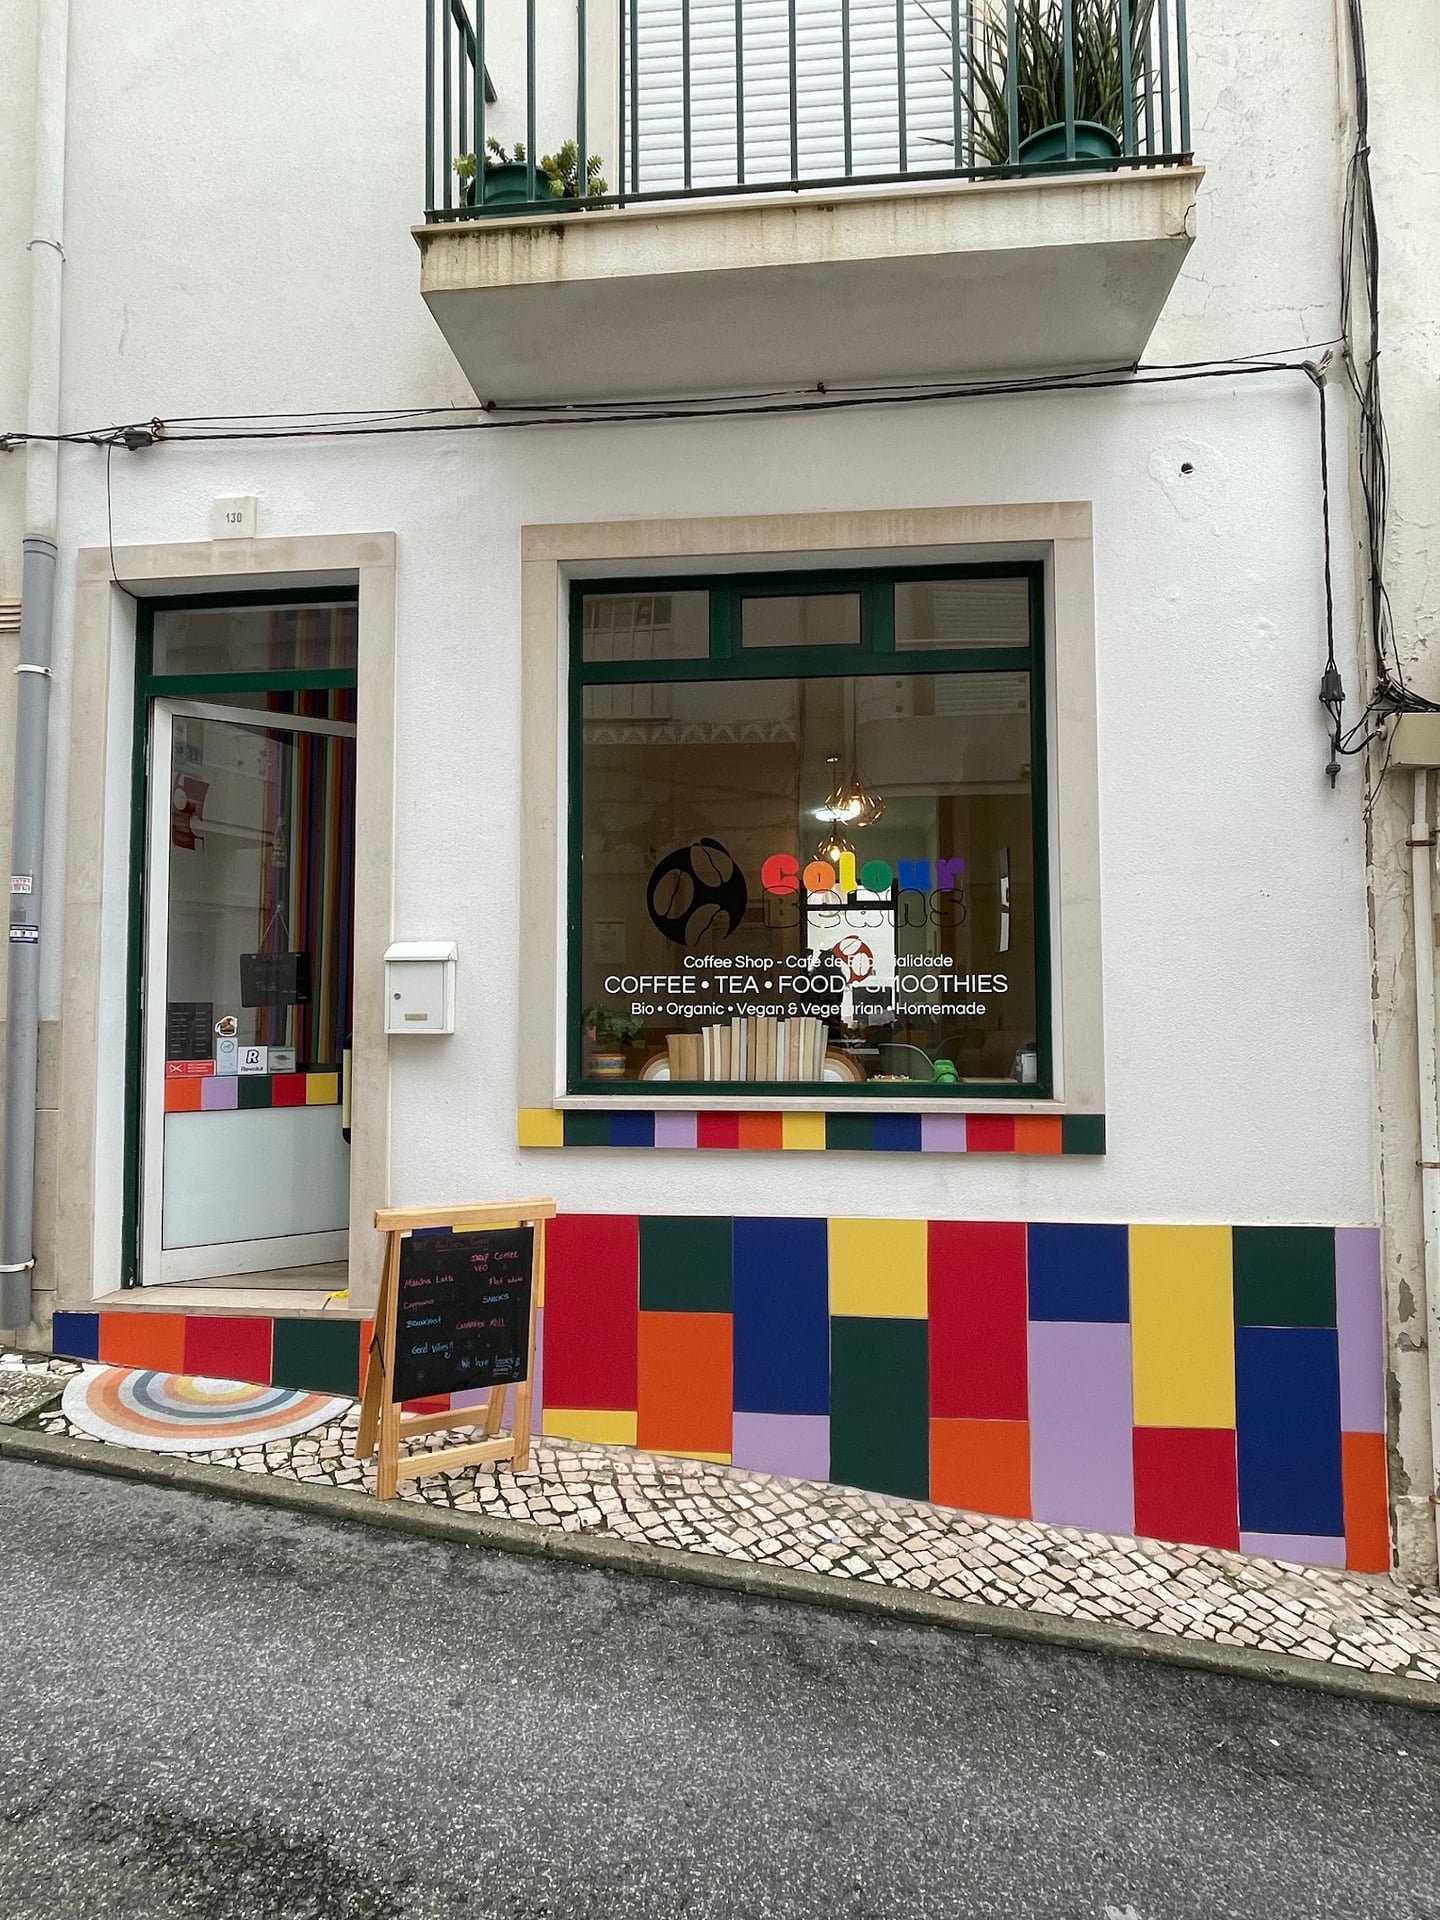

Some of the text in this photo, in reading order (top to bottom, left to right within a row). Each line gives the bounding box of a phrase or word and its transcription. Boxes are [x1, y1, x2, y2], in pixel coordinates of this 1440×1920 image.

[225, 512, 243, 523] 130
[763, 886, 967, 928] Beans
[684, 955, 732, 968] Coffee
[735, 955, 773, 971] Shop
[786, 954, 820, 968] Café
[825, 955, 841, 968] de
[604, 975, 696, 994] COFFEE
[714, 975, 760, 994] TEA
[779, 975, 846, 994] FOOD
[631, 1002, 654, 1015] Bio
[666, 1002, 725, 1017] Organic
[736, 1002, 784, 1017] Vegan
[788, 1002, 798, 1015] &
[896, 1001, 986, 1015] Homemade
[240, 1065, 263, 1073] Revolut
